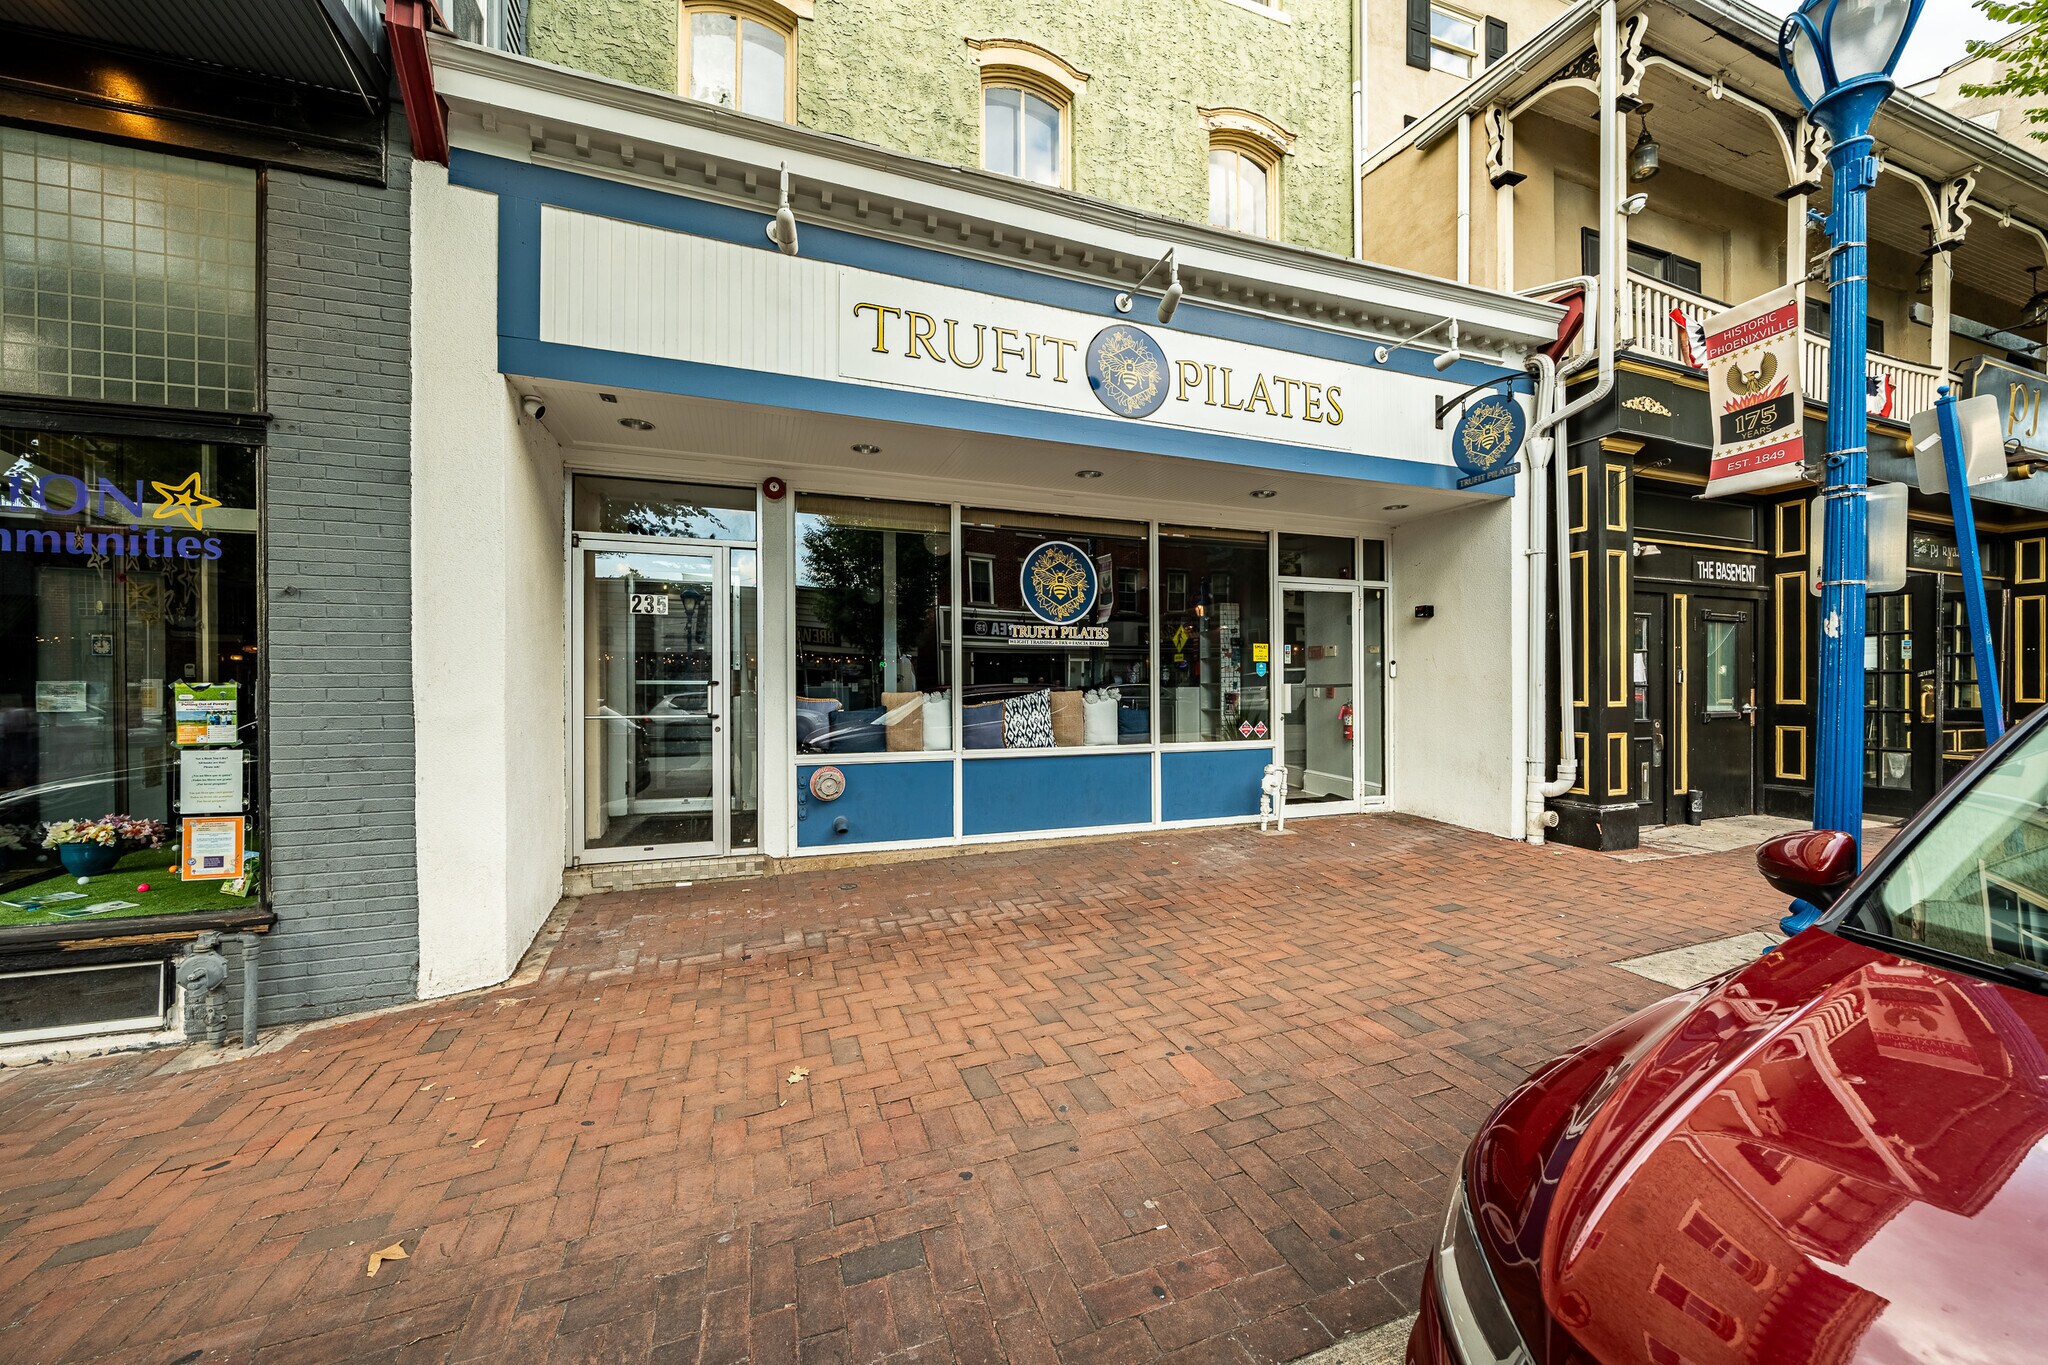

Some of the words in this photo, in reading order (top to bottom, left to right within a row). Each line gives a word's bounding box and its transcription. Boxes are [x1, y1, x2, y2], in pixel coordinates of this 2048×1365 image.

[1723, 312, 1777, 341] HISTORIC
[1709, 318, 1795, 358] PHOENIXVILLE
[853, 302, 1078, 383] TRUFIT
[1175, 359, 1344, 426] PILATES
[1735, 404, 1778, 434] 175
[1741, 425, 1772, 440] YEARS
[1727, 458, 1751, 471] EST.
[1754, 450, 1786, 465] 1849
[1460, 473, 1486, 487] TRUFIT
[1486, 464, 1518, 480] PILATES
[0, 524, 223, 560] munities
[1942, 545, 1960, 560] Rya
[1697, 561, 1714, 579] THE
[1715, 561, 1756, 582] BASEMENT
[632, 595, 666, 613] 235
[1009, 625, 1059, 639] TRUFIT
[1060, 626, 1109, 640] PILATES
